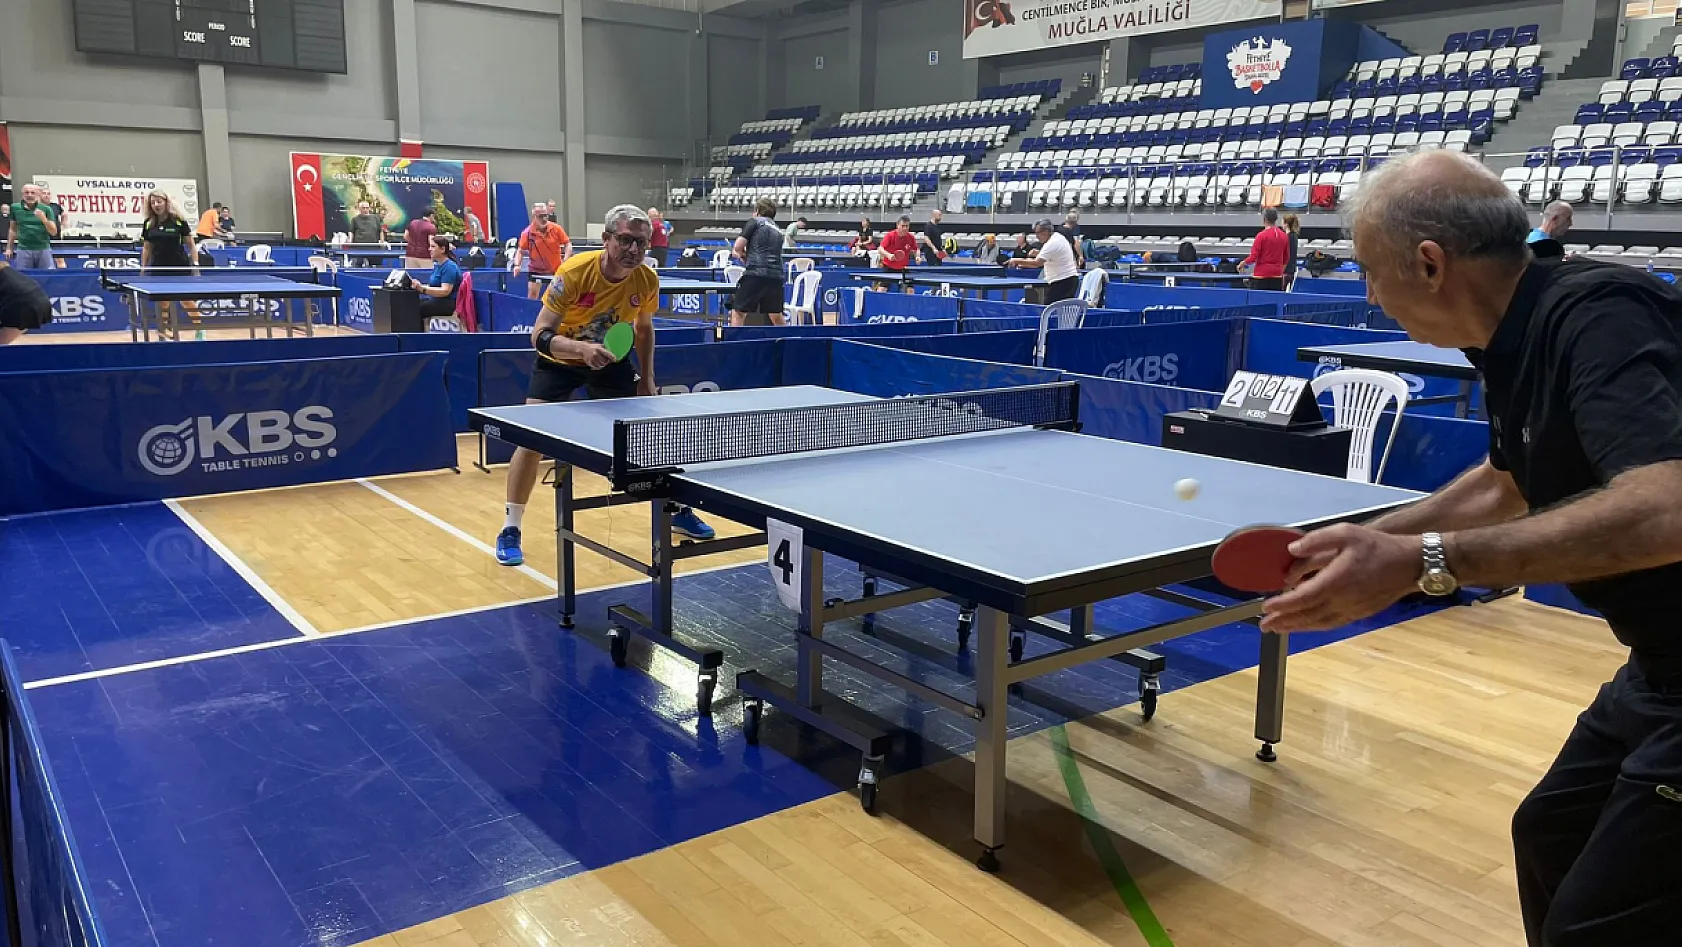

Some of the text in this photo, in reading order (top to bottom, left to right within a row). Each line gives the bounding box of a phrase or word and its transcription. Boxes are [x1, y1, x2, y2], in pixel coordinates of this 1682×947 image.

[1022, 1, 1088, 21] CENTİLMENCE
[1048, 0, 1191, 40] MUĞLA VALİLİĞİ
[183, 31, 251, 48] SCORE SCORE
[77, 180, 156, 190] UYSALLAR OTO
[57, 190, 127, 214] FETHİYE
[677, 293, 700, 309] KBS
[1125, 353, 1179, 382] KBS
[1225, 379, 1246, 405] 2
[1275, 384, 1299, 412] 11
[1246, 409, 1268, 419] KBS
[198, 405, 337, 458] KBS
[202, 454, 289, 473] TABLE TENNIS
[773, 538, 794, 586] 4
